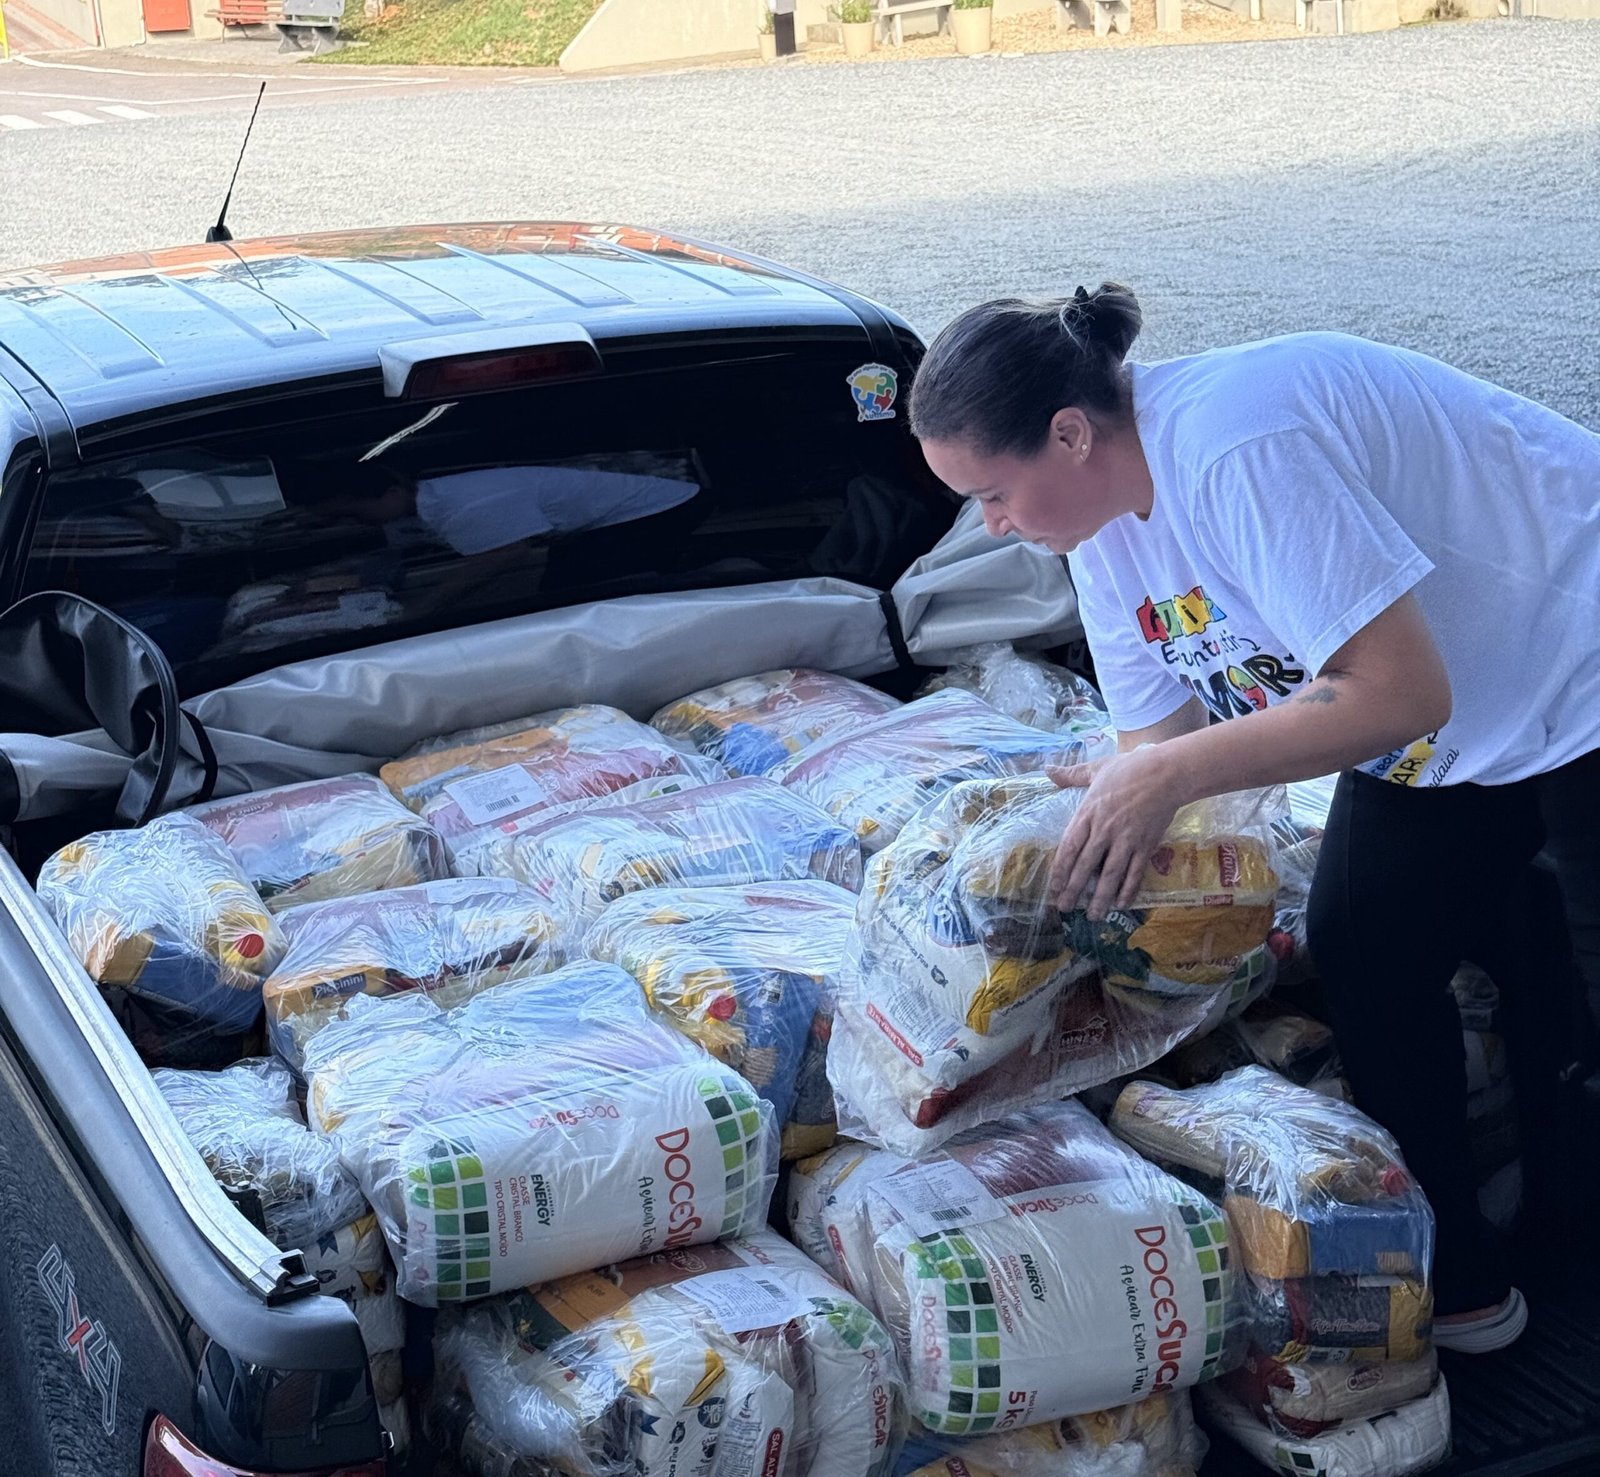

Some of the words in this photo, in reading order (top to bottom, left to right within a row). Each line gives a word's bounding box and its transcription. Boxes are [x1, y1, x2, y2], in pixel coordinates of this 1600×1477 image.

[494, 1179, 504, 1199] TIPO
[509, 1177, 519, 1208] CRISTAL
[518, 1175, 530, 1206] CLASSE
[531, 1174, 551, 1226] ENERGY
[496, 1200, 507, 1231] CRISTAL
[513, 1208, 524, 1242] BRANCO
[1008, 1255, 1024, 1281] CLASSE
[1020, 1253, 1045, 1303] ENERGY
[1119, 1264, 1140, 1321] Açúcar
[1131, 1322, 1147, 1363] Extra
[709, 1413, 720, 1423] 10
[771, 1432, 781, 1454] SAL
